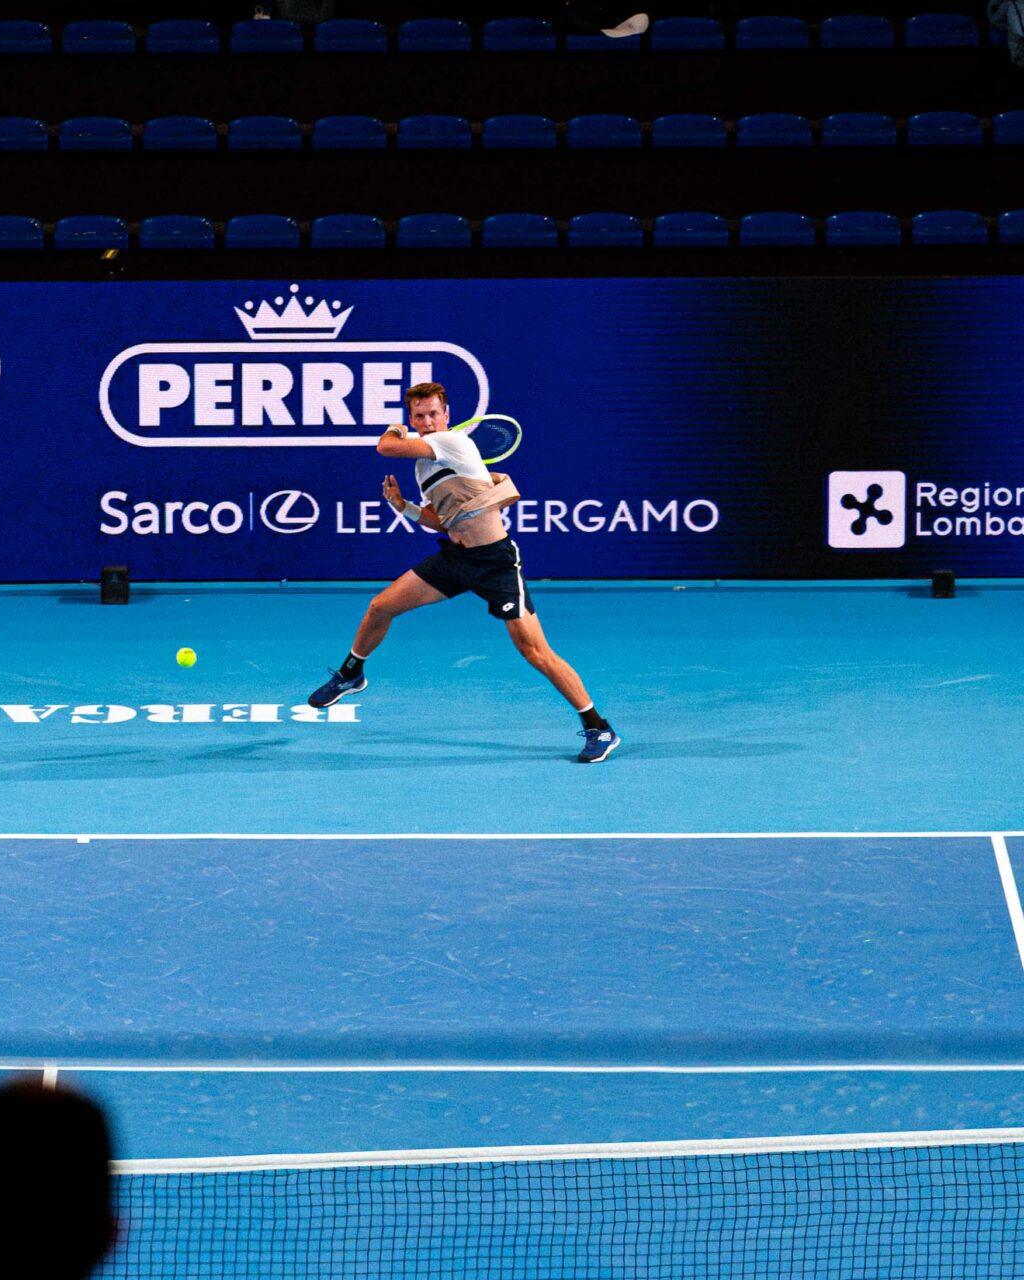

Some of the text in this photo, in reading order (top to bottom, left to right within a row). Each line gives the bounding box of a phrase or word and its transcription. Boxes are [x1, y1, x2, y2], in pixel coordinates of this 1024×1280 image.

[100, 490, 244, 535] Sarco
[336, 501, 440, 534] LEX
[916, 511, 1024, 536] Lomba
